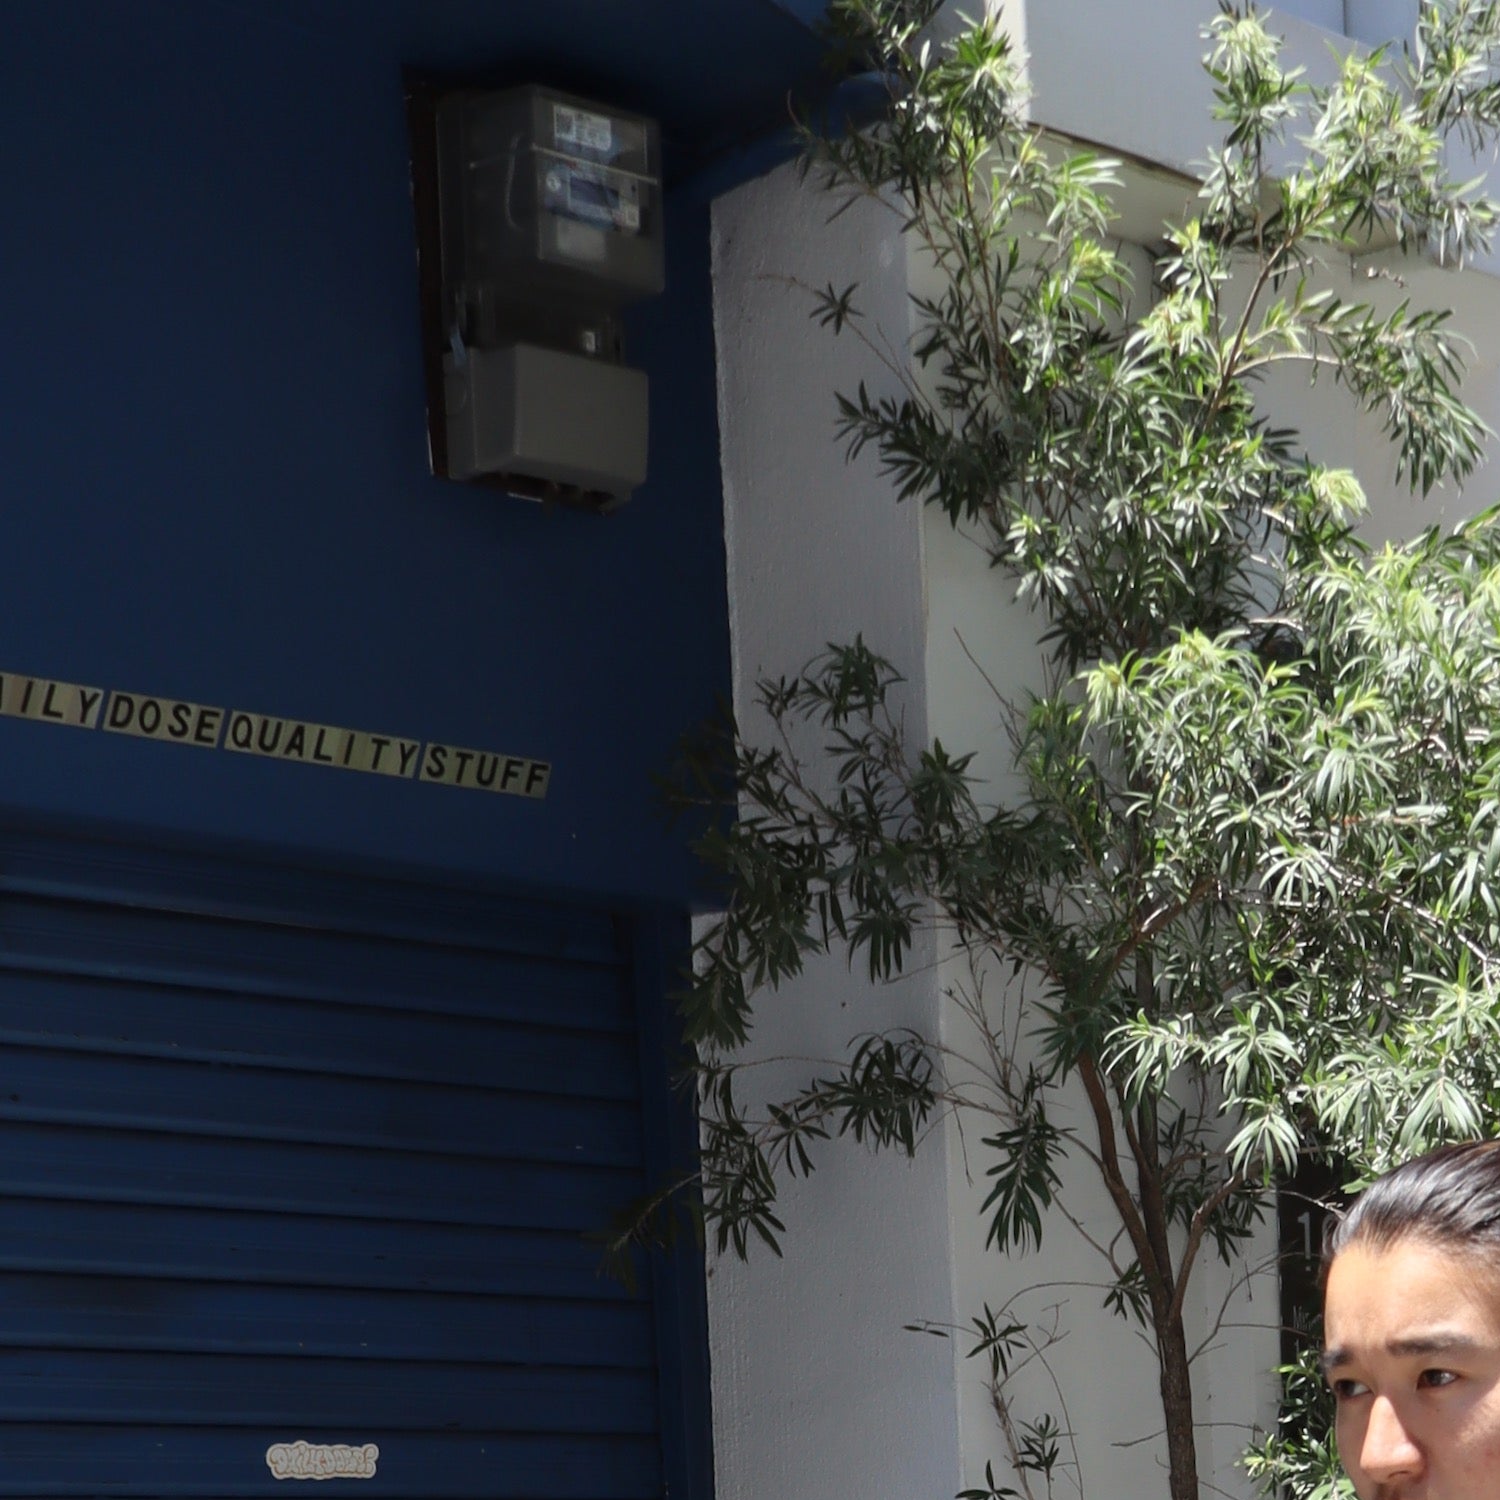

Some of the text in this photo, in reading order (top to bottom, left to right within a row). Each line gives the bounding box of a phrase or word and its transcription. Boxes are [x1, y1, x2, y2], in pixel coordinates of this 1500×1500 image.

[109, 694, 220, 744] DOSE
[231, 714, 418, 776] QUALITY
[425, 745, 549, 795] STUFF
